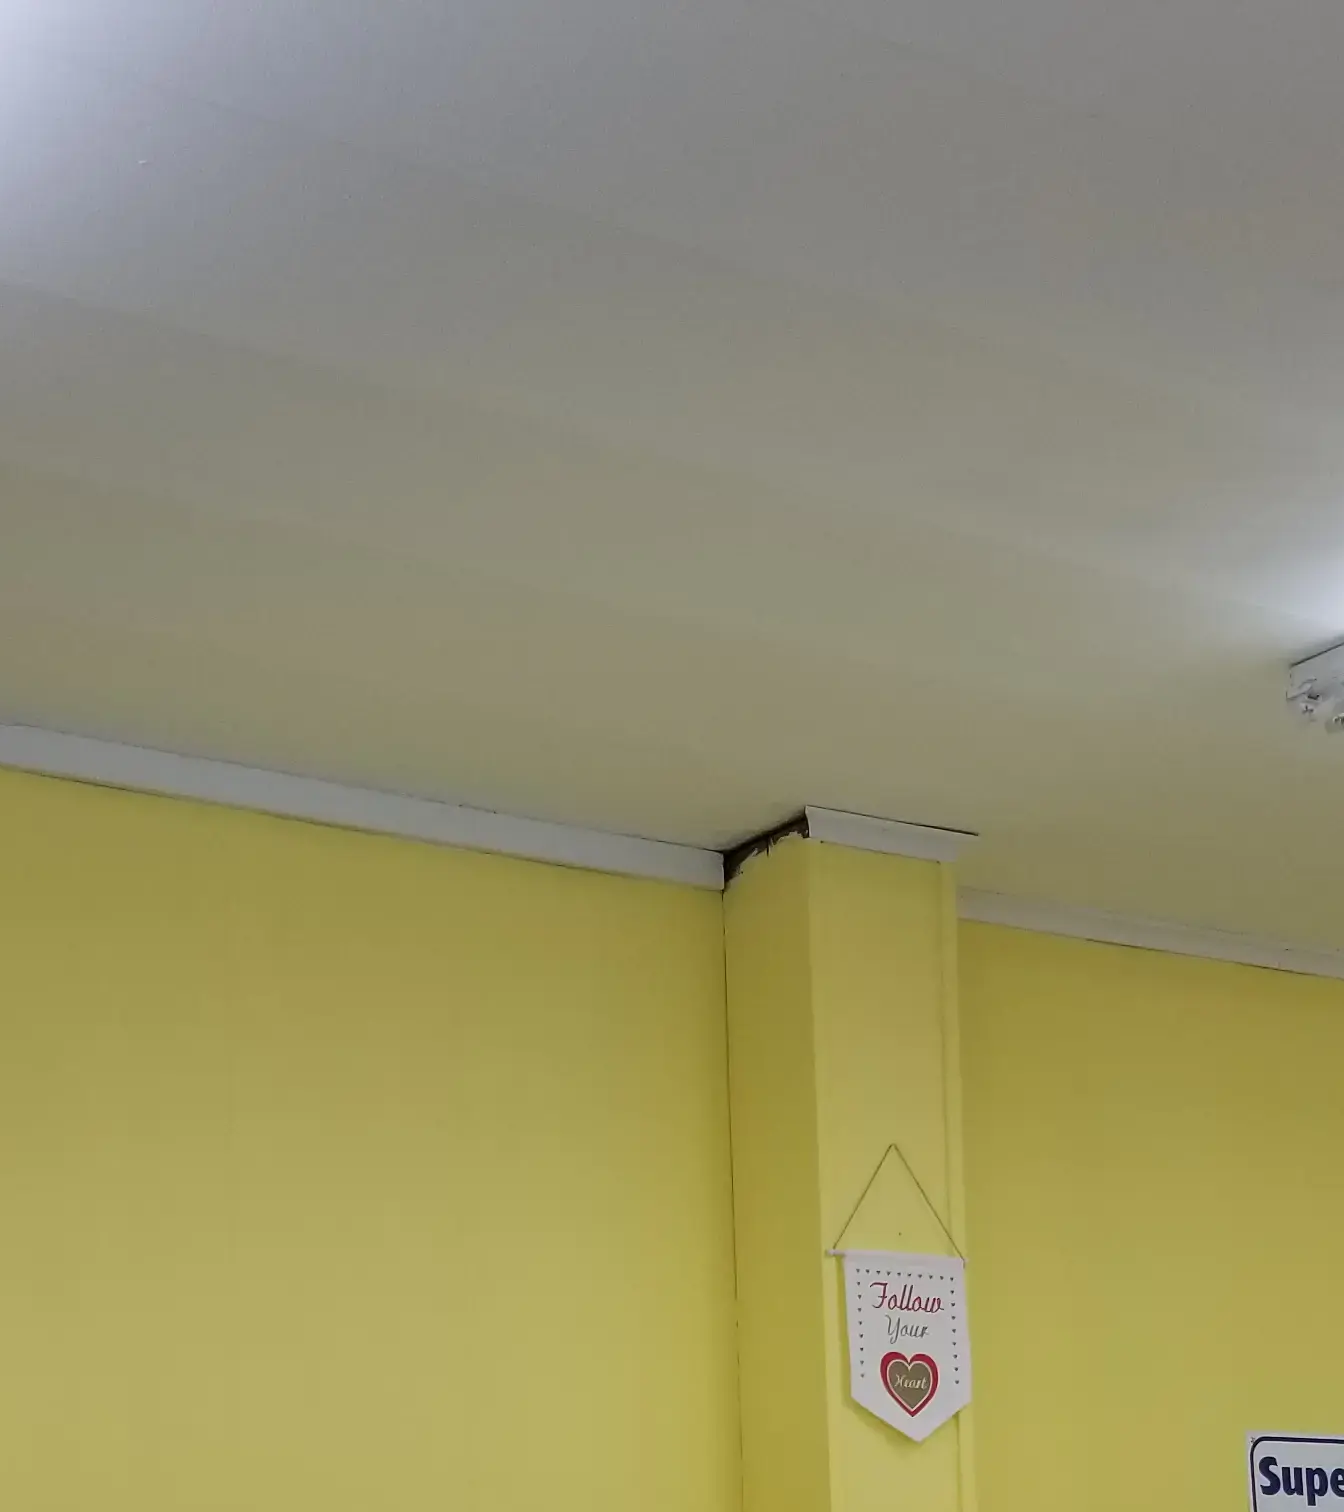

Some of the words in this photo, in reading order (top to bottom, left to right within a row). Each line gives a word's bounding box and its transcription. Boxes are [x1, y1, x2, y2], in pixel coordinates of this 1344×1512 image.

[869, 1281, 945, 1314] Follow
[885, 1314, 929, 1344] Your
[894, 1373, 928, 1391] Heart
